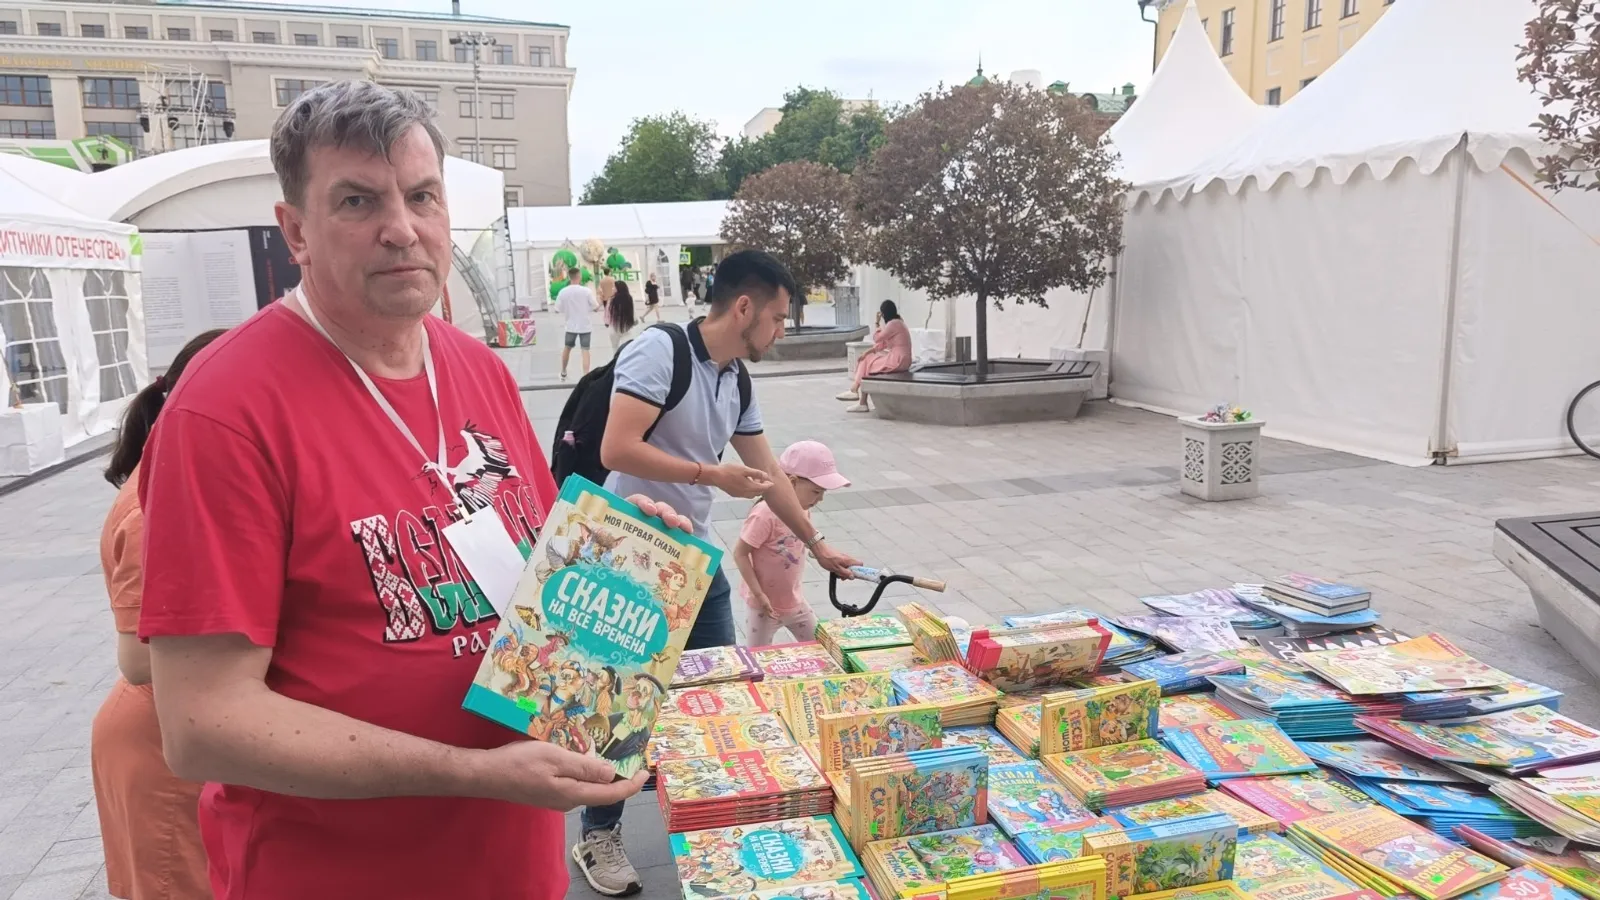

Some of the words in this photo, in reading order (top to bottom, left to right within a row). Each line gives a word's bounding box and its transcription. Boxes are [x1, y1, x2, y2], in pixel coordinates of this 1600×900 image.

[604, 514, 621, 529] МОЯ
[623, 521, 652, 543] ПЕРВАЯ
[654, 538, 681, 560] СКАЗКА
[557, 570, 660, 644] СКАЗКИ
[548, 599, 565, 619] НА
[568, 607, 590, 631] ВСЕ
[592, 617, 646, 655] ВРЕМЕНА
[752, 834, 760, 845] НА
[754, 845, 764, 856] ВСЕ
[759, 833, 796, 873] СКАЗКИ
[757, 854, 773, 876] ВРЕМЕНА
[1507, 881, 1540, 896] 50
